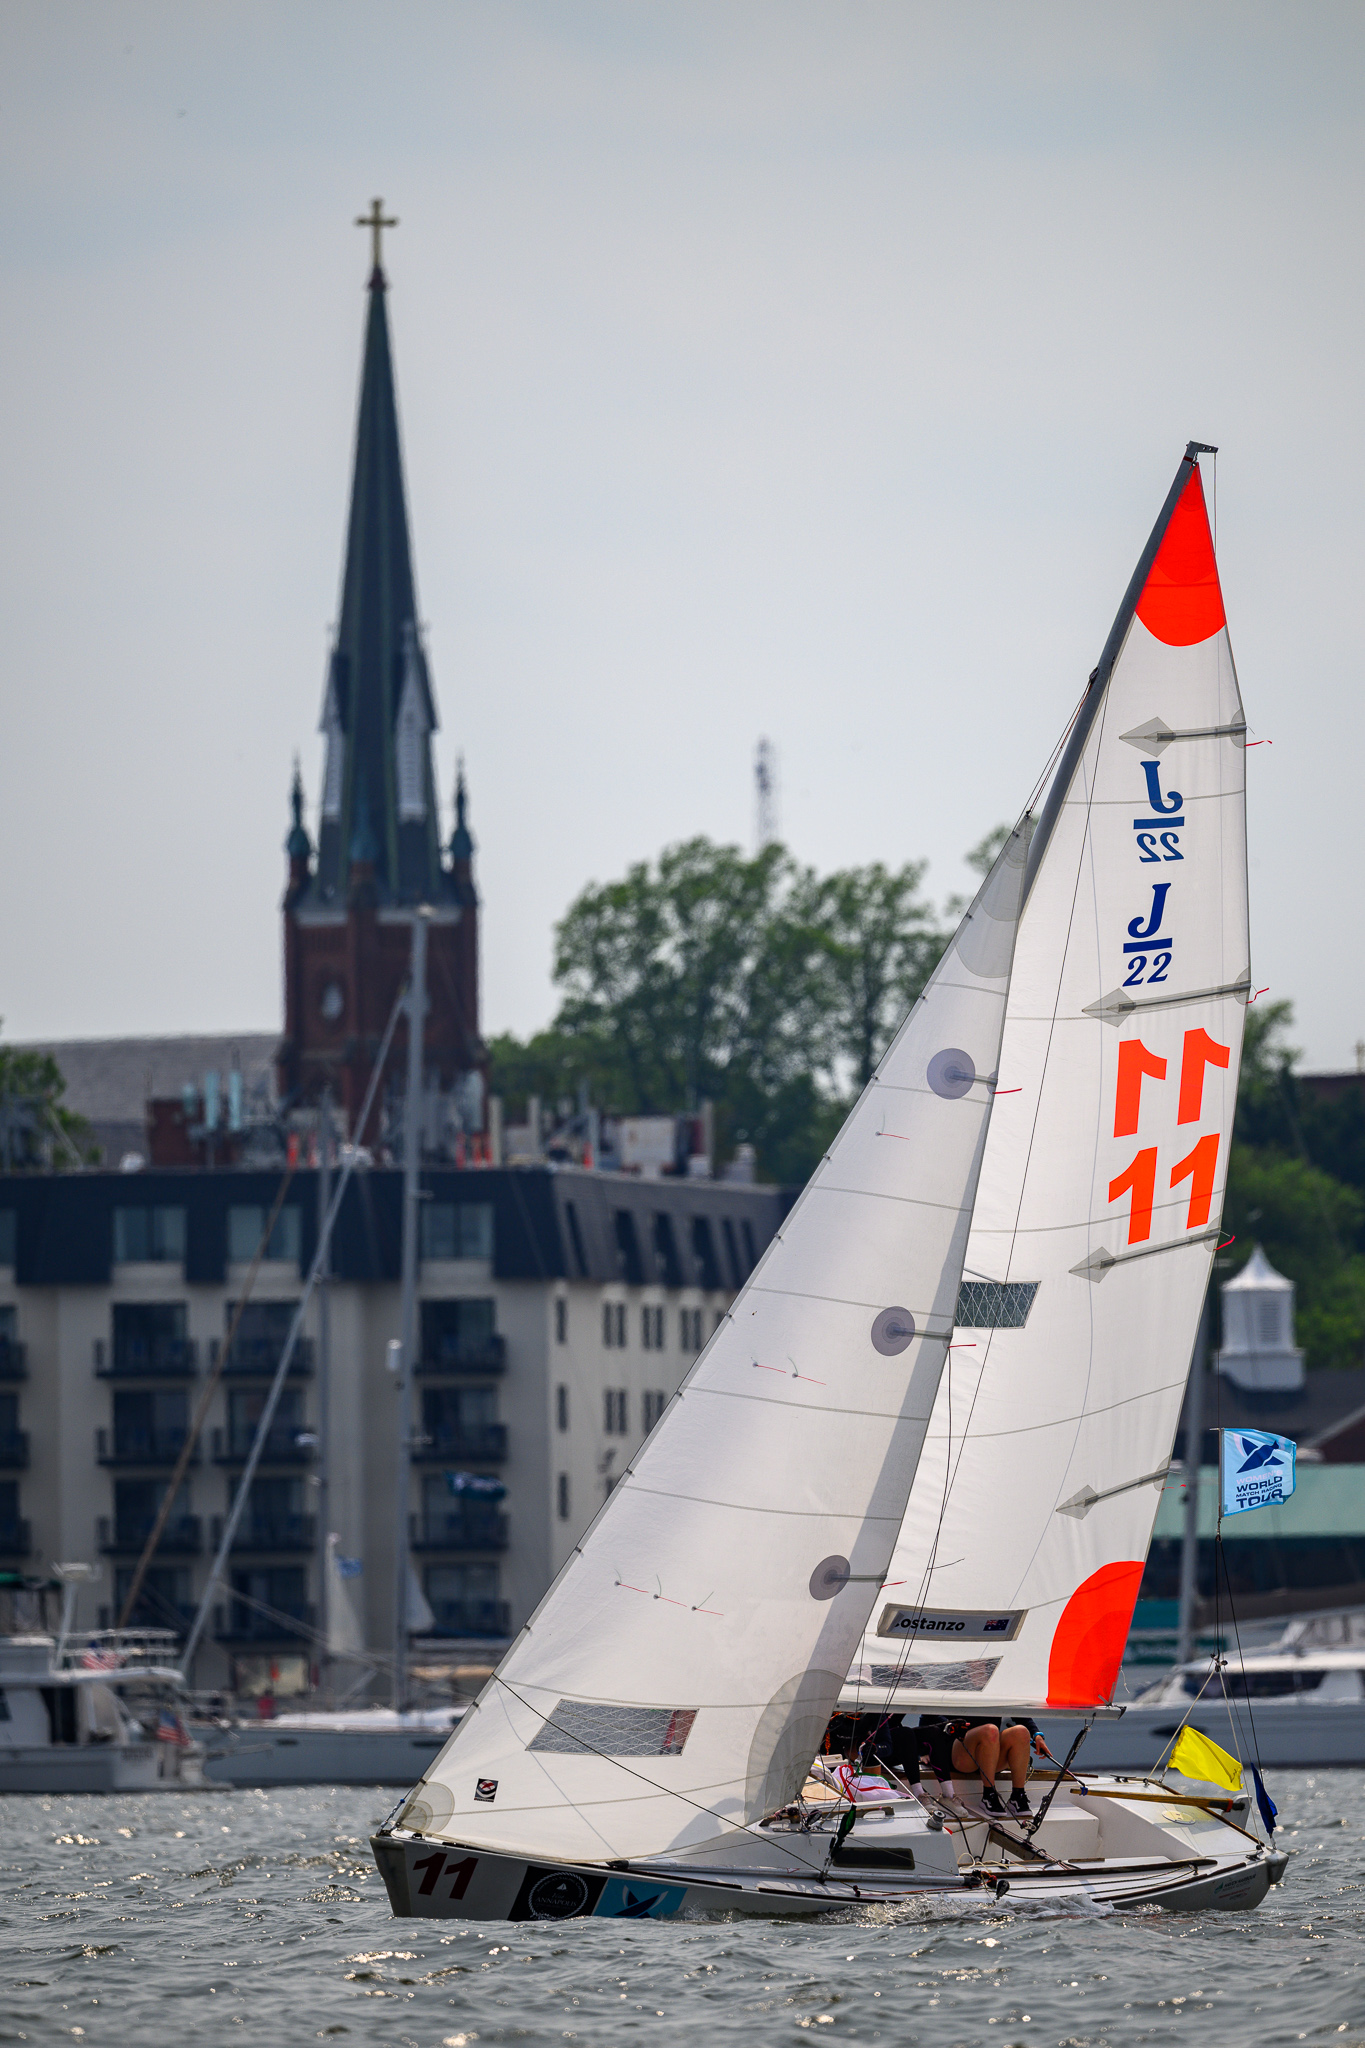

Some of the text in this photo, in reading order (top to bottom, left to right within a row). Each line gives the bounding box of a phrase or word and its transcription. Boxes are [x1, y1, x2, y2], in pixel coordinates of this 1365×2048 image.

[1127, 882, 1172, 939] J
[1122, 952, 1173, 987] 22
[1108, 1133, 1221, 1245] 11
[1236, 1476, 1283, 1492] WORLD
[1236, 1490, 1260, 1498] MATCH
[1236, 1489, 1283, 1508] TOUR
[895, 1617, 966, 1631] ostanzo
[412, 1852, 479, 1901] 11
[535, 1897, 577, 1907] ANNAPOLIS
